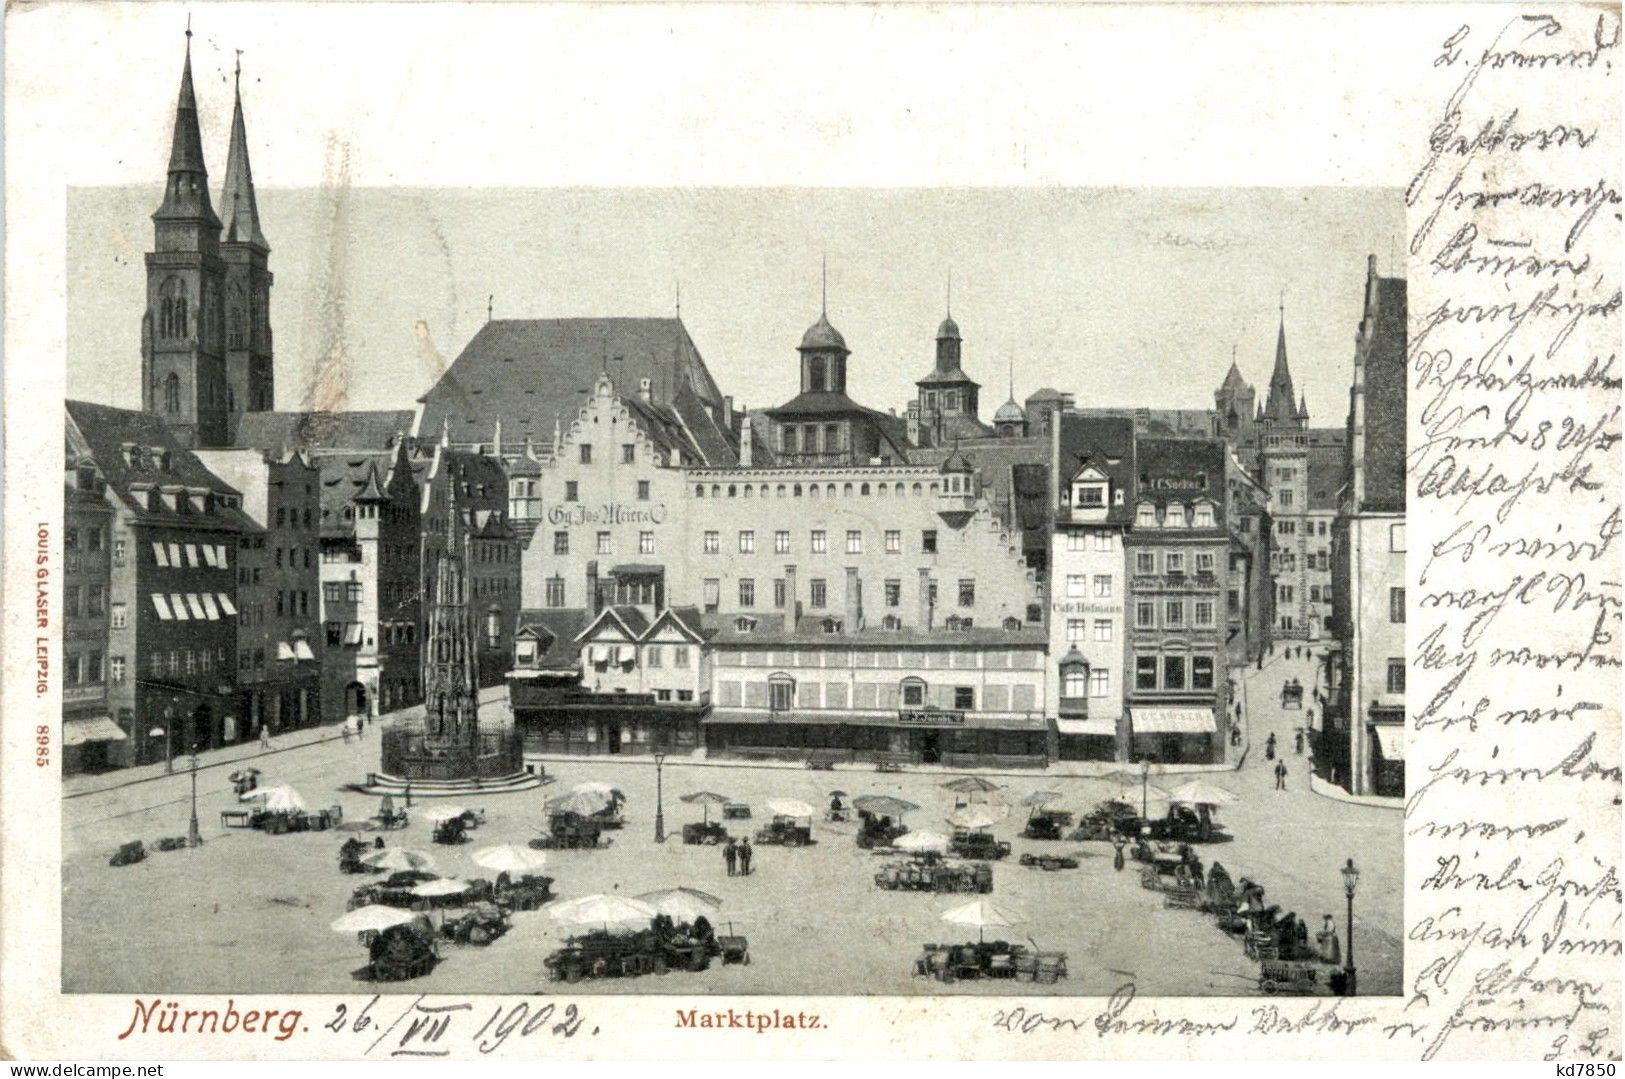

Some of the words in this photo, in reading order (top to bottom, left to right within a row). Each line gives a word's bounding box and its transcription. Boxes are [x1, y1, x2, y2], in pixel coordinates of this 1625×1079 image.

[37, 522, 49, 564] LOUIS
[37, 570, 49, 628] GLASER
[37, 637, 49, 699] LEIPZIG.
[37, 725, 50, 767] 8985
[118, 999, 309, 1041] Nürnberg.
[675, 1008, 828, 1033] Marktplatz.
